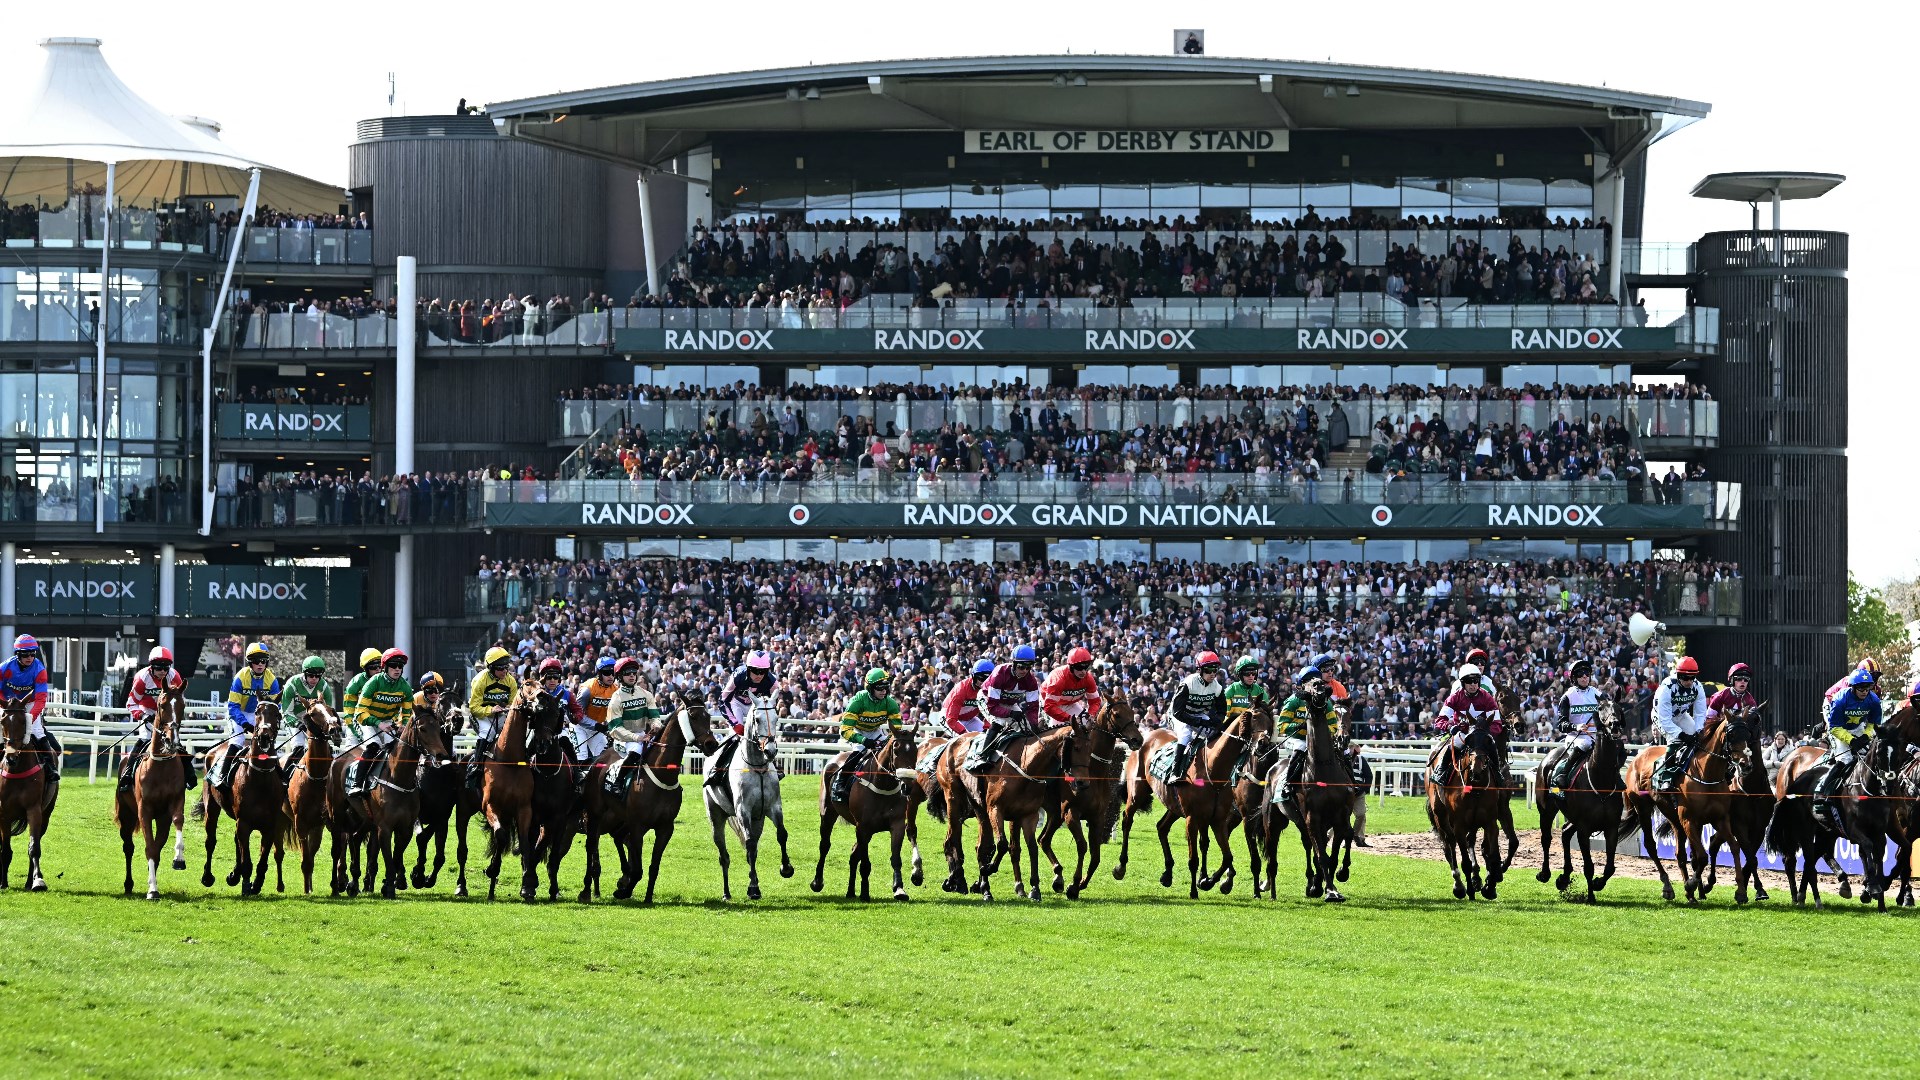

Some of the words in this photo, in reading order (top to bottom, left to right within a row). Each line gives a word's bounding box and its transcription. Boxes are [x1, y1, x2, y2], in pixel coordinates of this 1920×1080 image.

[979, 133, 1043, 150] EARL
[1053, 133, 1086, 150] OF
[1098, 133, 1176, 150] DERBY
[1189, 133, 1274, 150] STAND
[665, 330, 774, 350] RANDOX
[875, 330, 984, 350] RANDOX
[1086, 330, 1195, 350] RANDOX
[1298, 330, 1408, 350] RANDOX
[1512, 330, 1622, 350] RANDOX
[245, 412, 342, 432] RANDOX
[582, 504, 694, 525] RANDOX
[904, 504, 1017, 525] RANDOX
[1031, 504, 1128, 525] GRAND
[1140, 504, 1276, 526] NATIONAL
[1489, 504, 1604, 526] RANDOX
[35, 580, 135, 598] RANDOX
[208, 582, 307, 600] RANDOX
[375, 695, 403, 703] RANDOX
[622, 698, 646, 708] RANDOX
[1570, 705, 1598, 713] RANDOX
